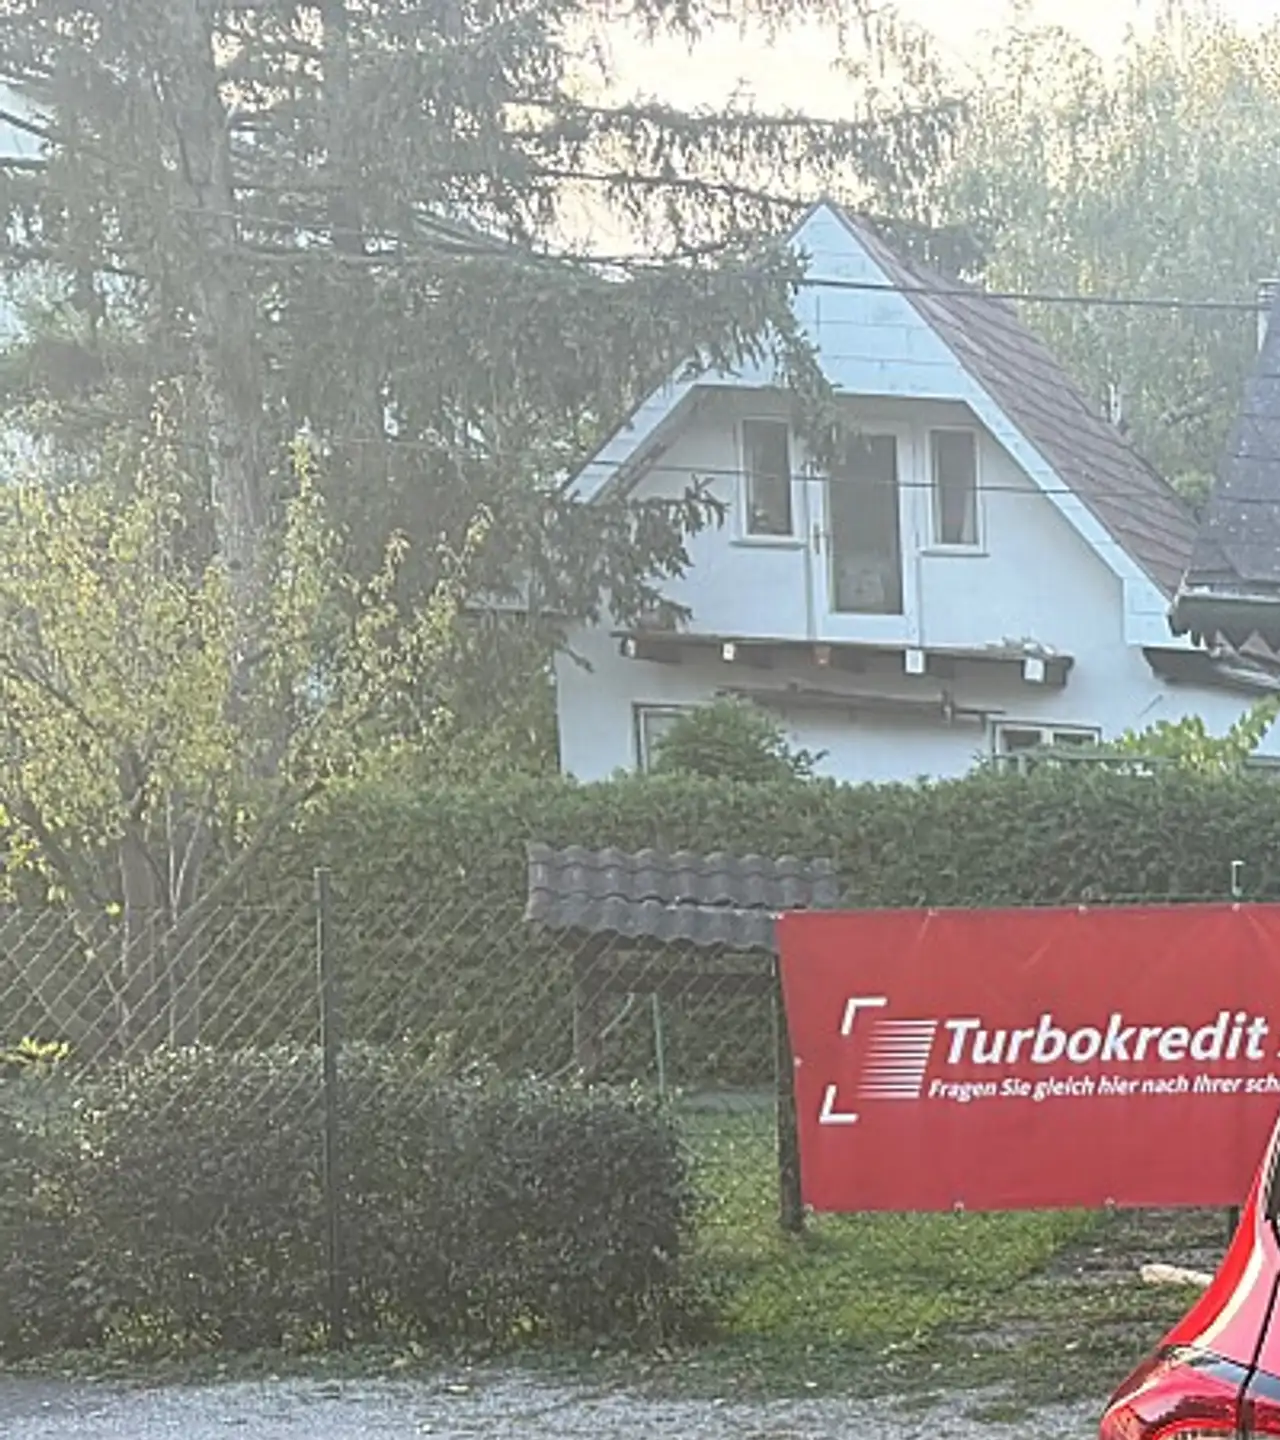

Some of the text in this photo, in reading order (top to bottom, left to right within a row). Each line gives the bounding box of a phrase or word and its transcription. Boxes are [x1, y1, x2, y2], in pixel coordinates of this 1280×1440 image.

[945, 1011, 1268, 1065] Turbokredit
[928, 1078, 997, 1103] Fragen
[1000, 1077, 1031, 1097] Sie
[1032, 1074, 1095, 1102] gleich
[1098, 1074, 1139, 1096] hier
[1142, 1073, 1189, 1095] nach
[1193, 1072, 1243, 1094] Ihrer
